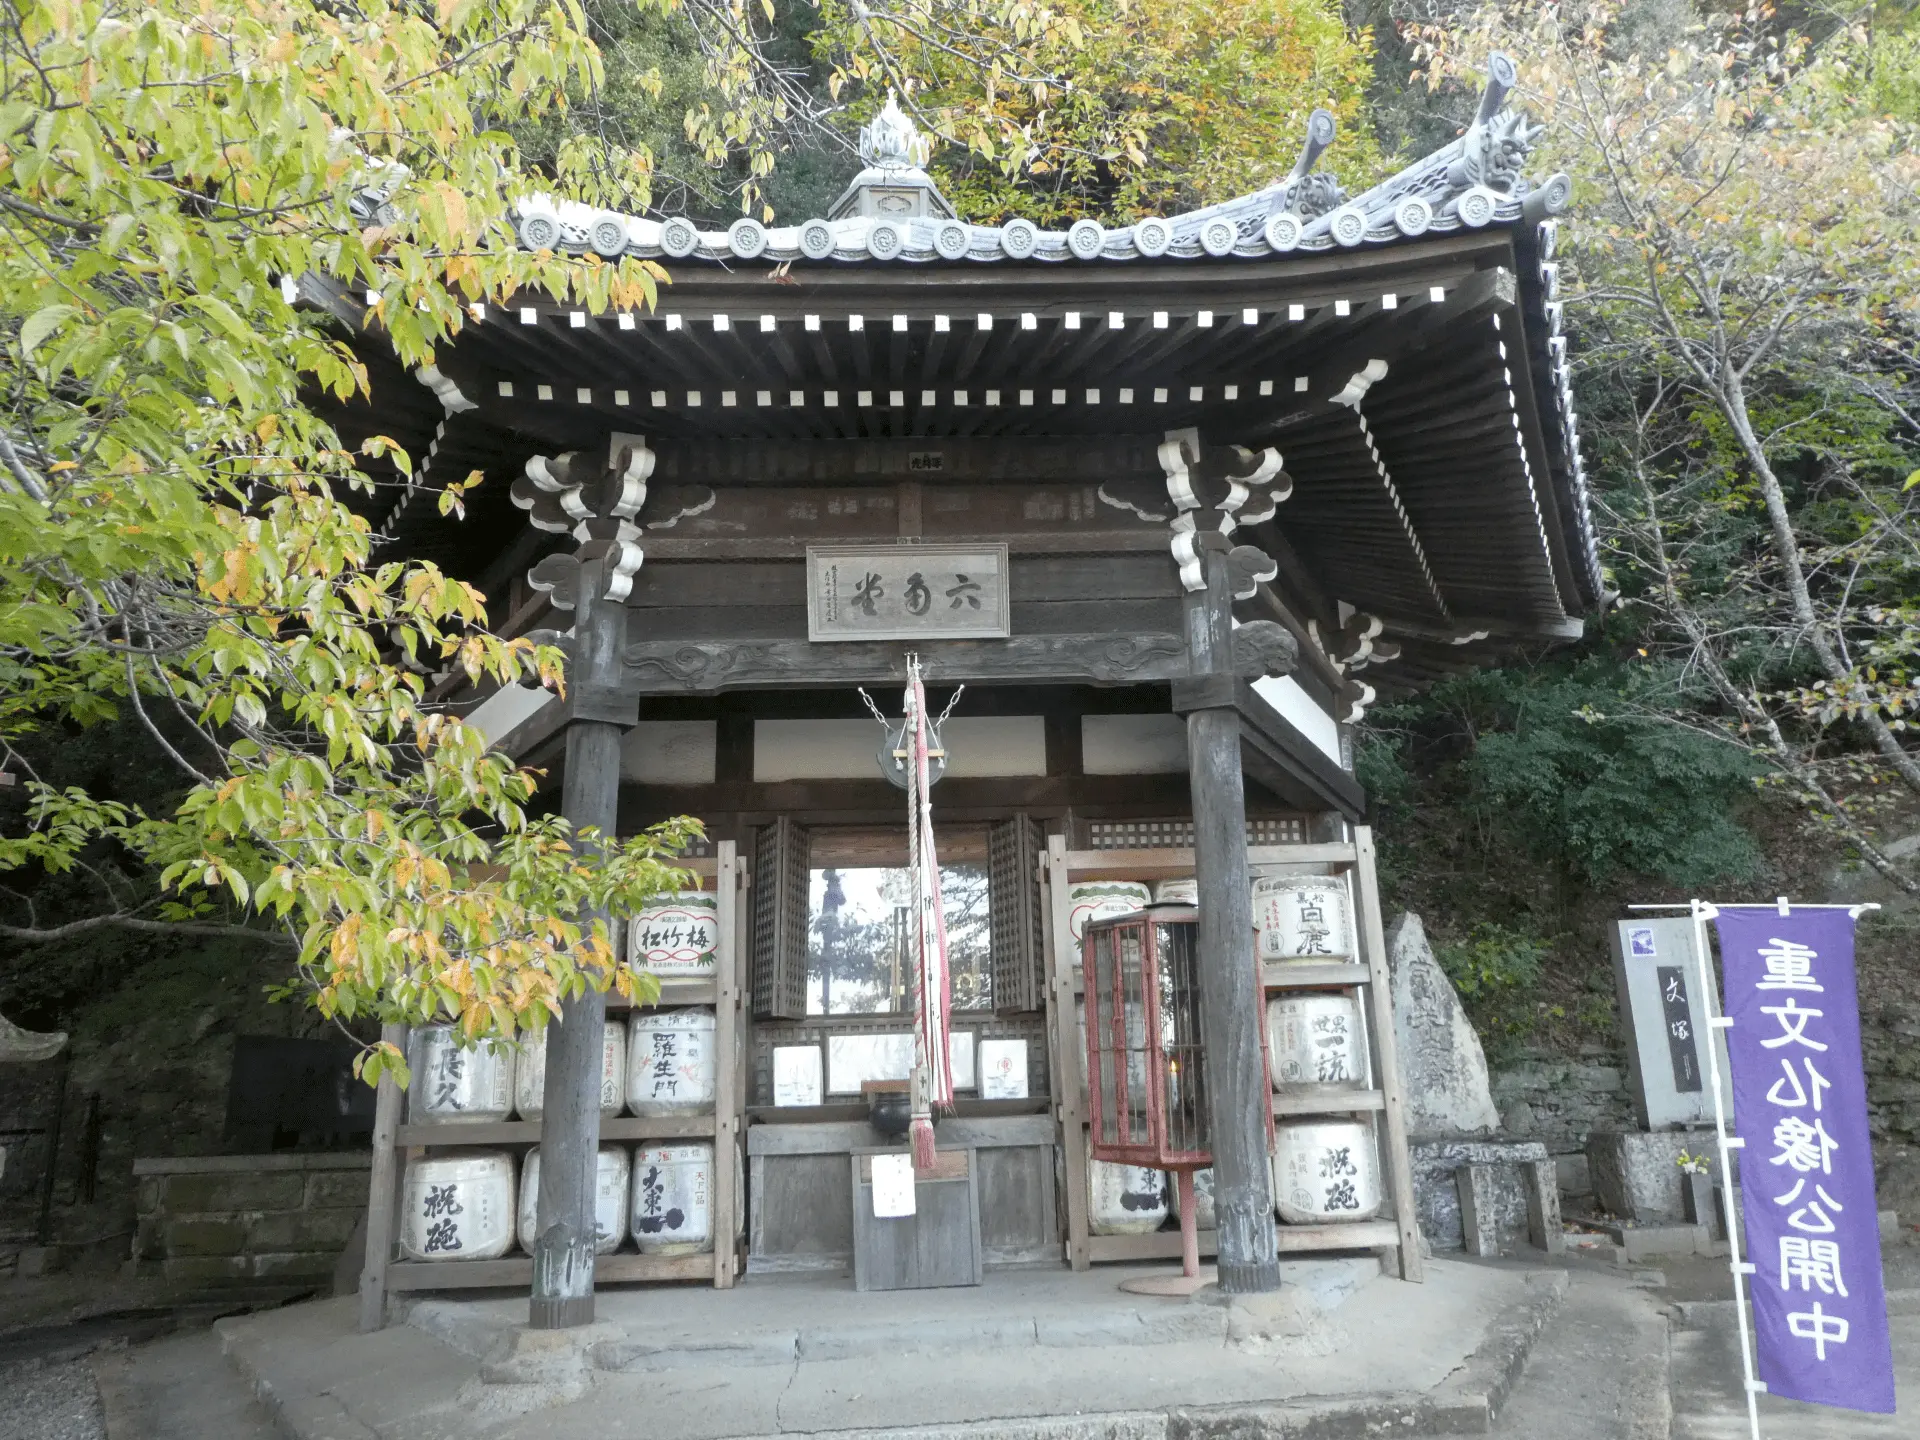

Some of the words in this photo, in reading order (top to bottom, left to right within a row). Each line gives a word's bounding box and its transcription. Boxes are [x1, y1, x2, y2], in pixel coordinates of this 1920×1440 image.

[851, 571, 981, 617] 六角堂
[641, 924, 710, 950] 松竹梅
[1296, 901, 1332, 955] 白鹿
[1666, 976, 1691, 1041] 文塚
[428, 1047, 465, 1110] 長久
[651, 1032, 678, 1098] 羅生門
[694, 1171, 705, 1206] 天下一品
